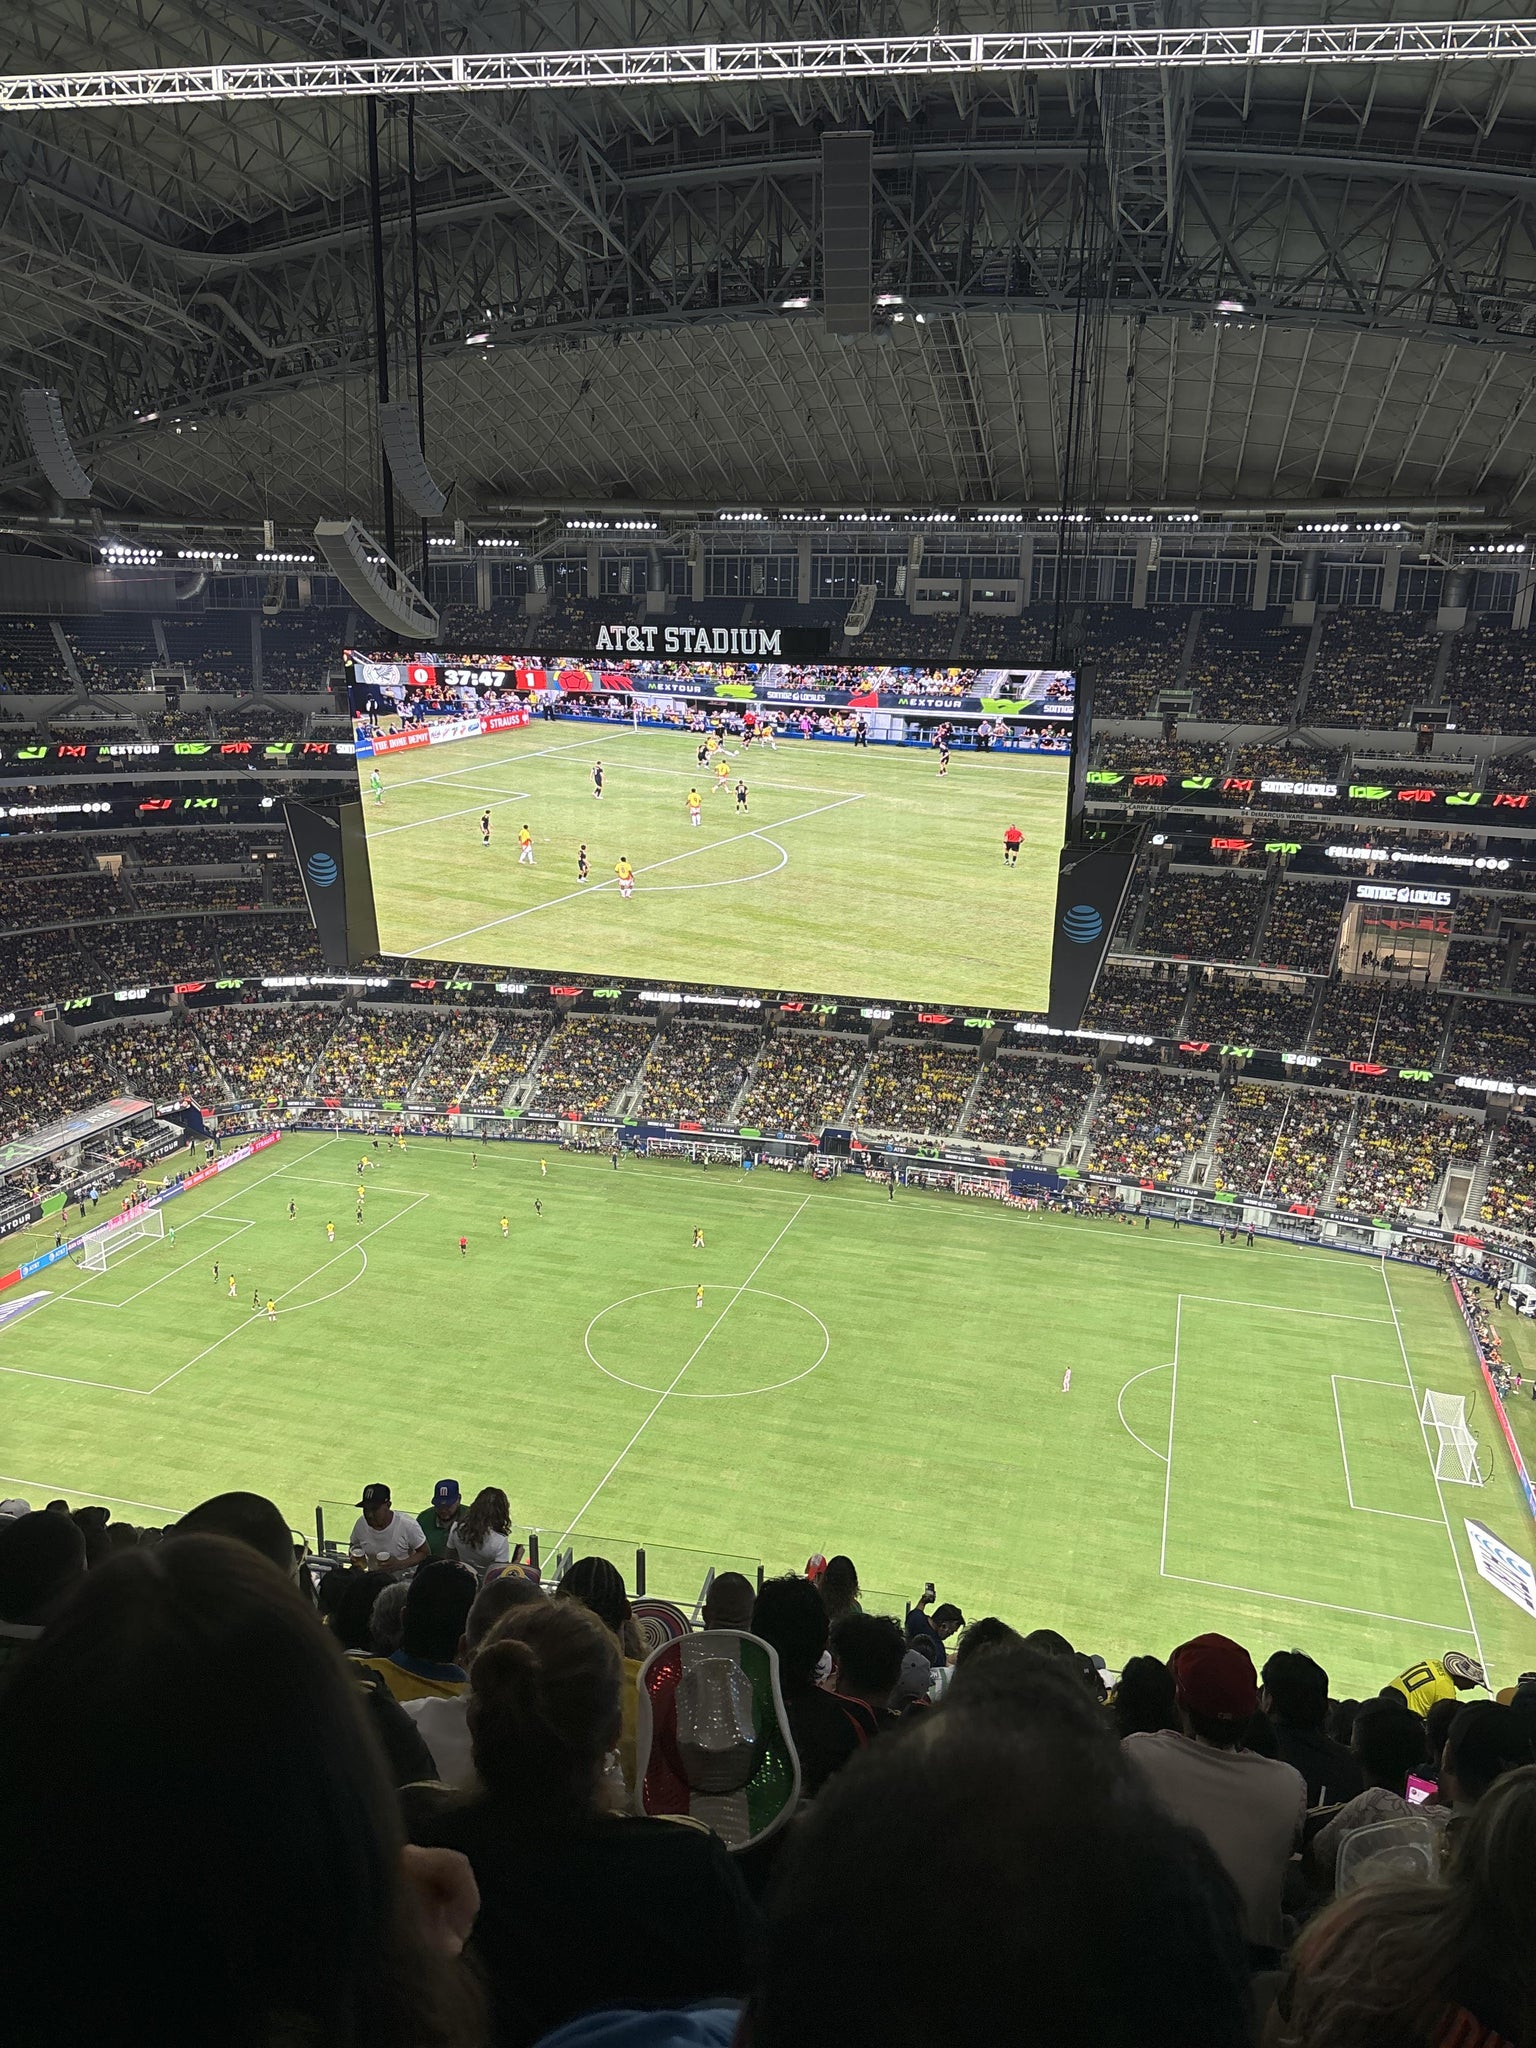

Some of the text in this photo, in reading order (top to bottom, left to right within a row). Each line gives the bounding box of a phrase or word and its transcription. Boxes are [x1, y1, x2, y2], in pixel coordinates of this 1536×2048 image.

[595, 624, 782, 656] AT&T STADIUM
[414, 668, 429, 683] 0
[444, 669, 506, 687] 37:47
[525, 672, 535, 687] 1
[647, 683, 701, 693] MEXTOUR
[898, 698, 962, 708] MEXTOUR
[489, 714, 520, 729] STRAUSS
[375, 739, 388, 750] THE
[408, 732, 430, 745] DEPOT
[99, 744, 160, 755] MEXTOUR
[1286, 812, 1305, 820] WARE
[1409, 889, 1451, 906] LOCALES
[150, 1140, 179, 1158] EXTOUR
[892, 1146, 907, 1154] AT&T
[1400, 1661, 1436, 1693] 10
